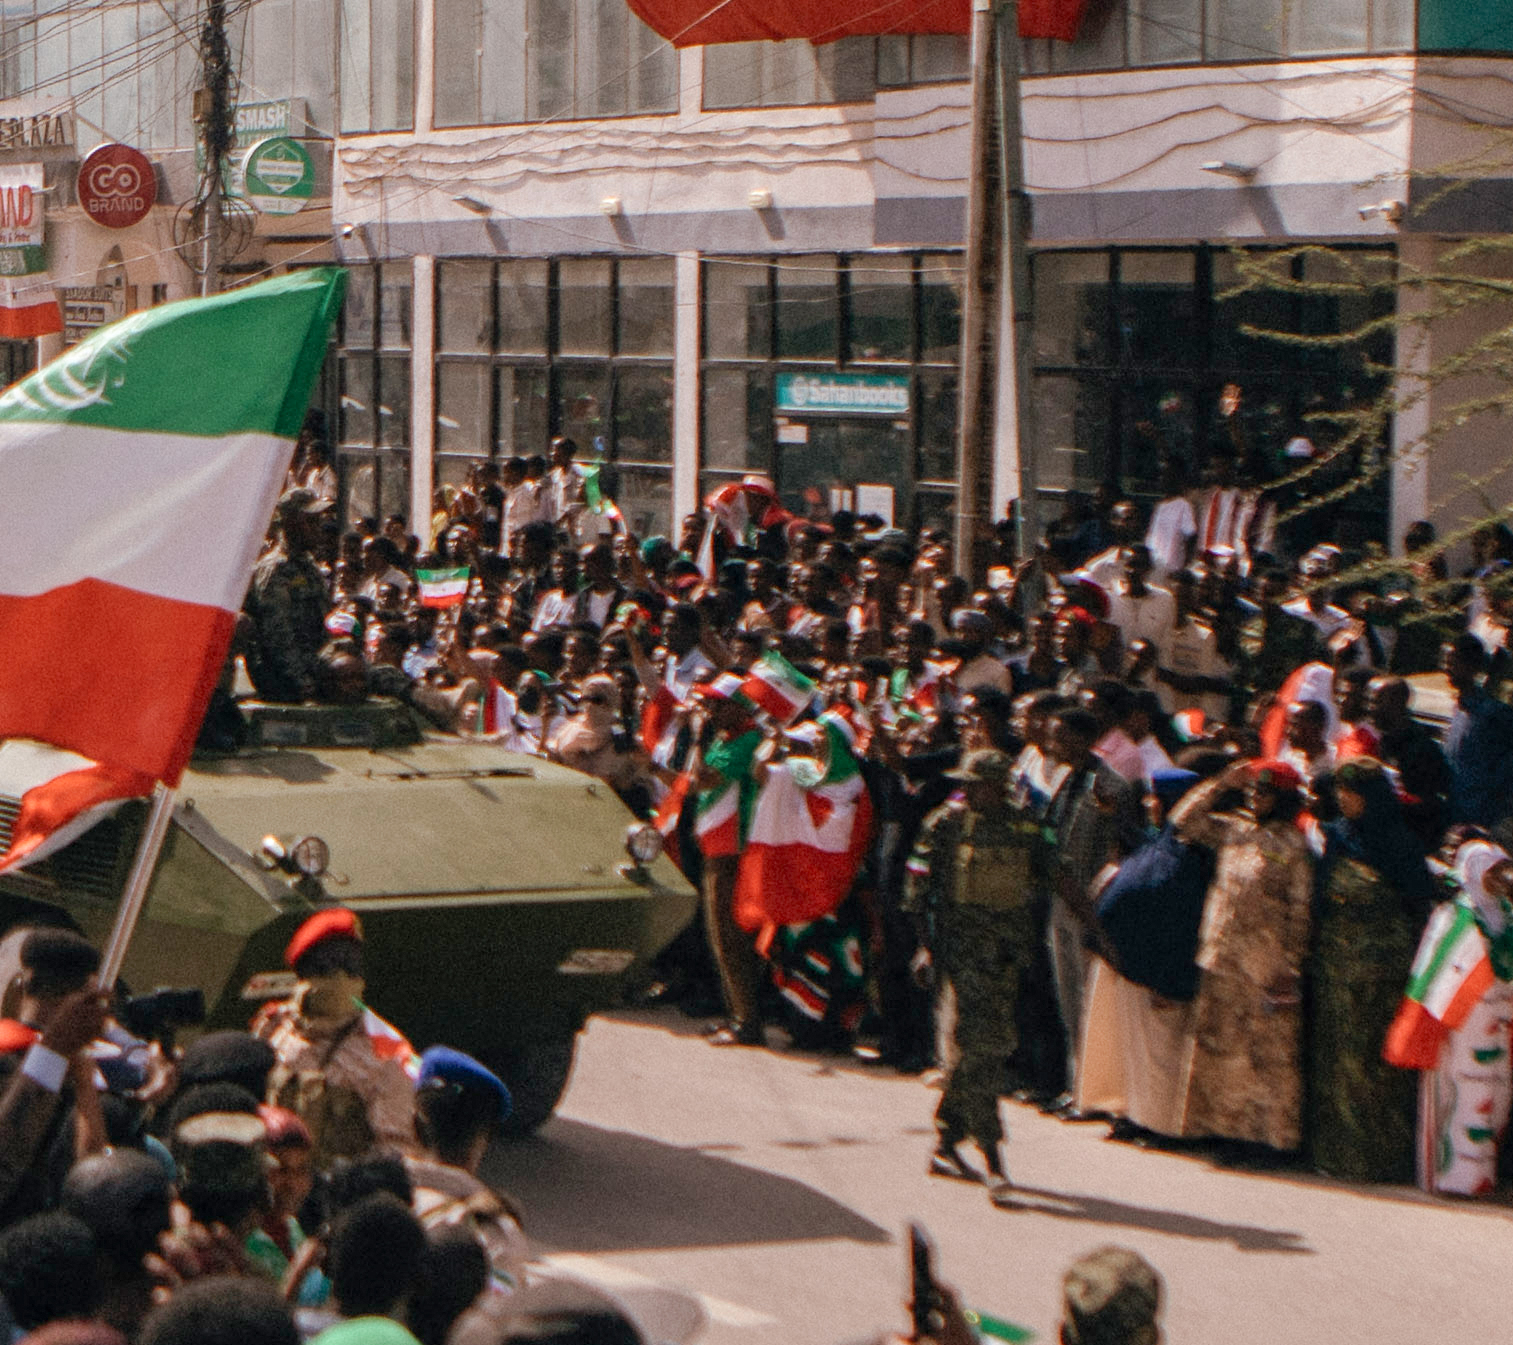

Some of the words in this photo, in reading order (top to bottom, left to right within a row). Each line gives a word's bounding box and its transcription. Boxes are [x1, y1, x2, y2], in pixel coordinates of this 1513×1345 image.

[237, 103, 286, 132] SMASH
[89, 164, 140, 197] GO
[89, 196, 144, 213] BRAND
